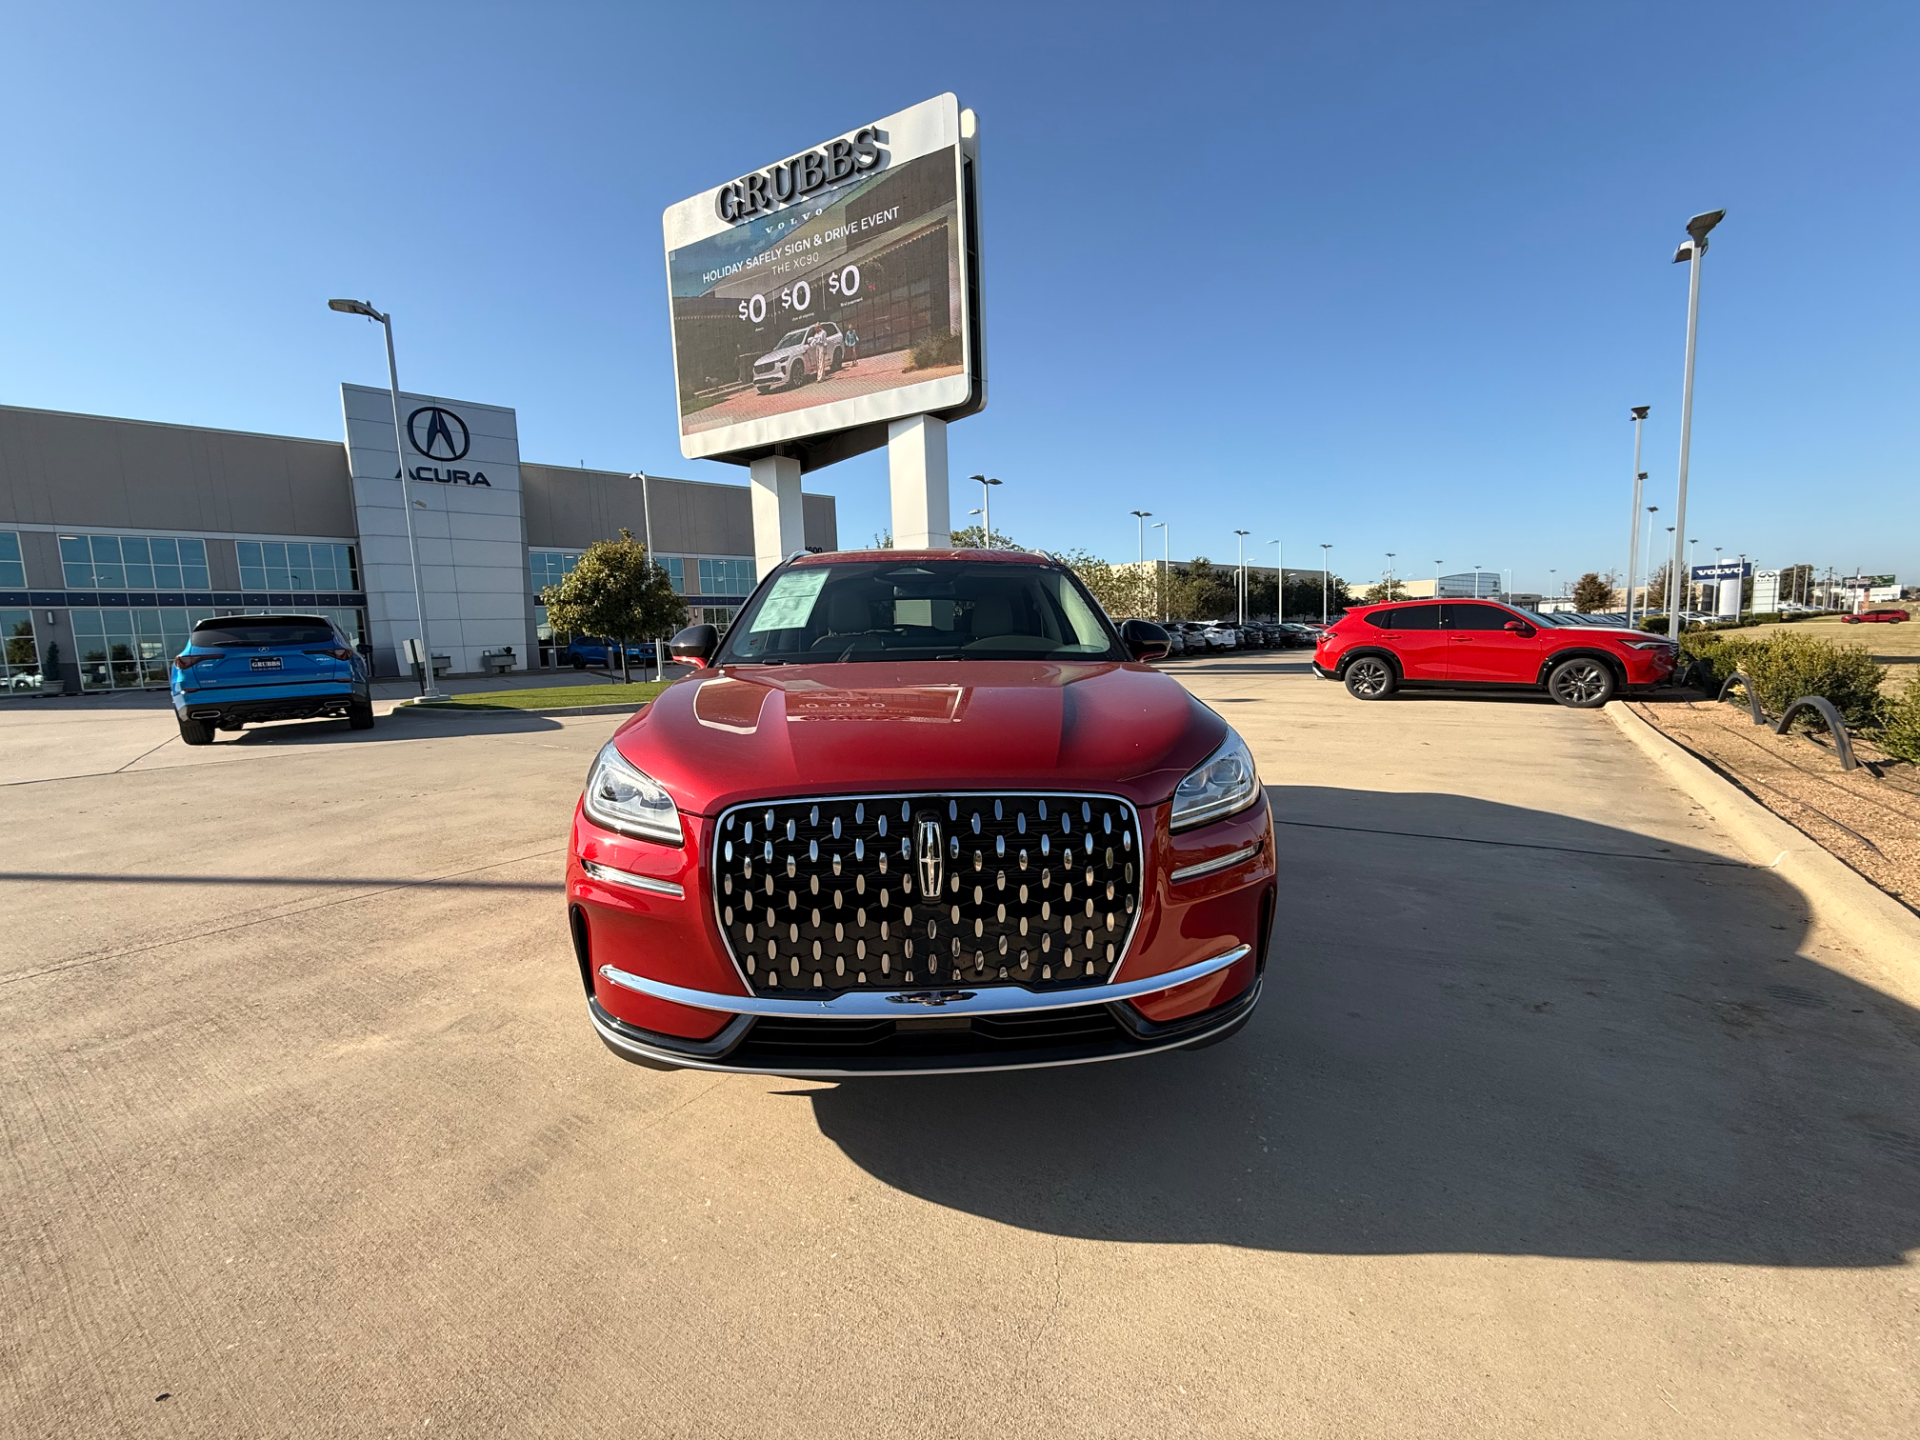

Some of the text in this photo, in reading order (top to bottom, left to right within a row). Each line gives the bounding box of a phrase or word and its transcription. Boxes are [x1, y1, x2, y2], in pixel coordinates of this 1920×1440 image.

[715, 125, 879, 223] GRUBBS
[765, 207, 823, 234] VOLVO
[702, 205, 900, 284] HOLIDAY SAFELY SIGN & DRIVE EVENT
[771, 252, 819, 276] THE XC90
[828, 264, 860, 296] $0
[738, 293, 767, 323] $0
[781, 280, 811, 311] $0
[1696, 567, 1744, 576] VOLVO
